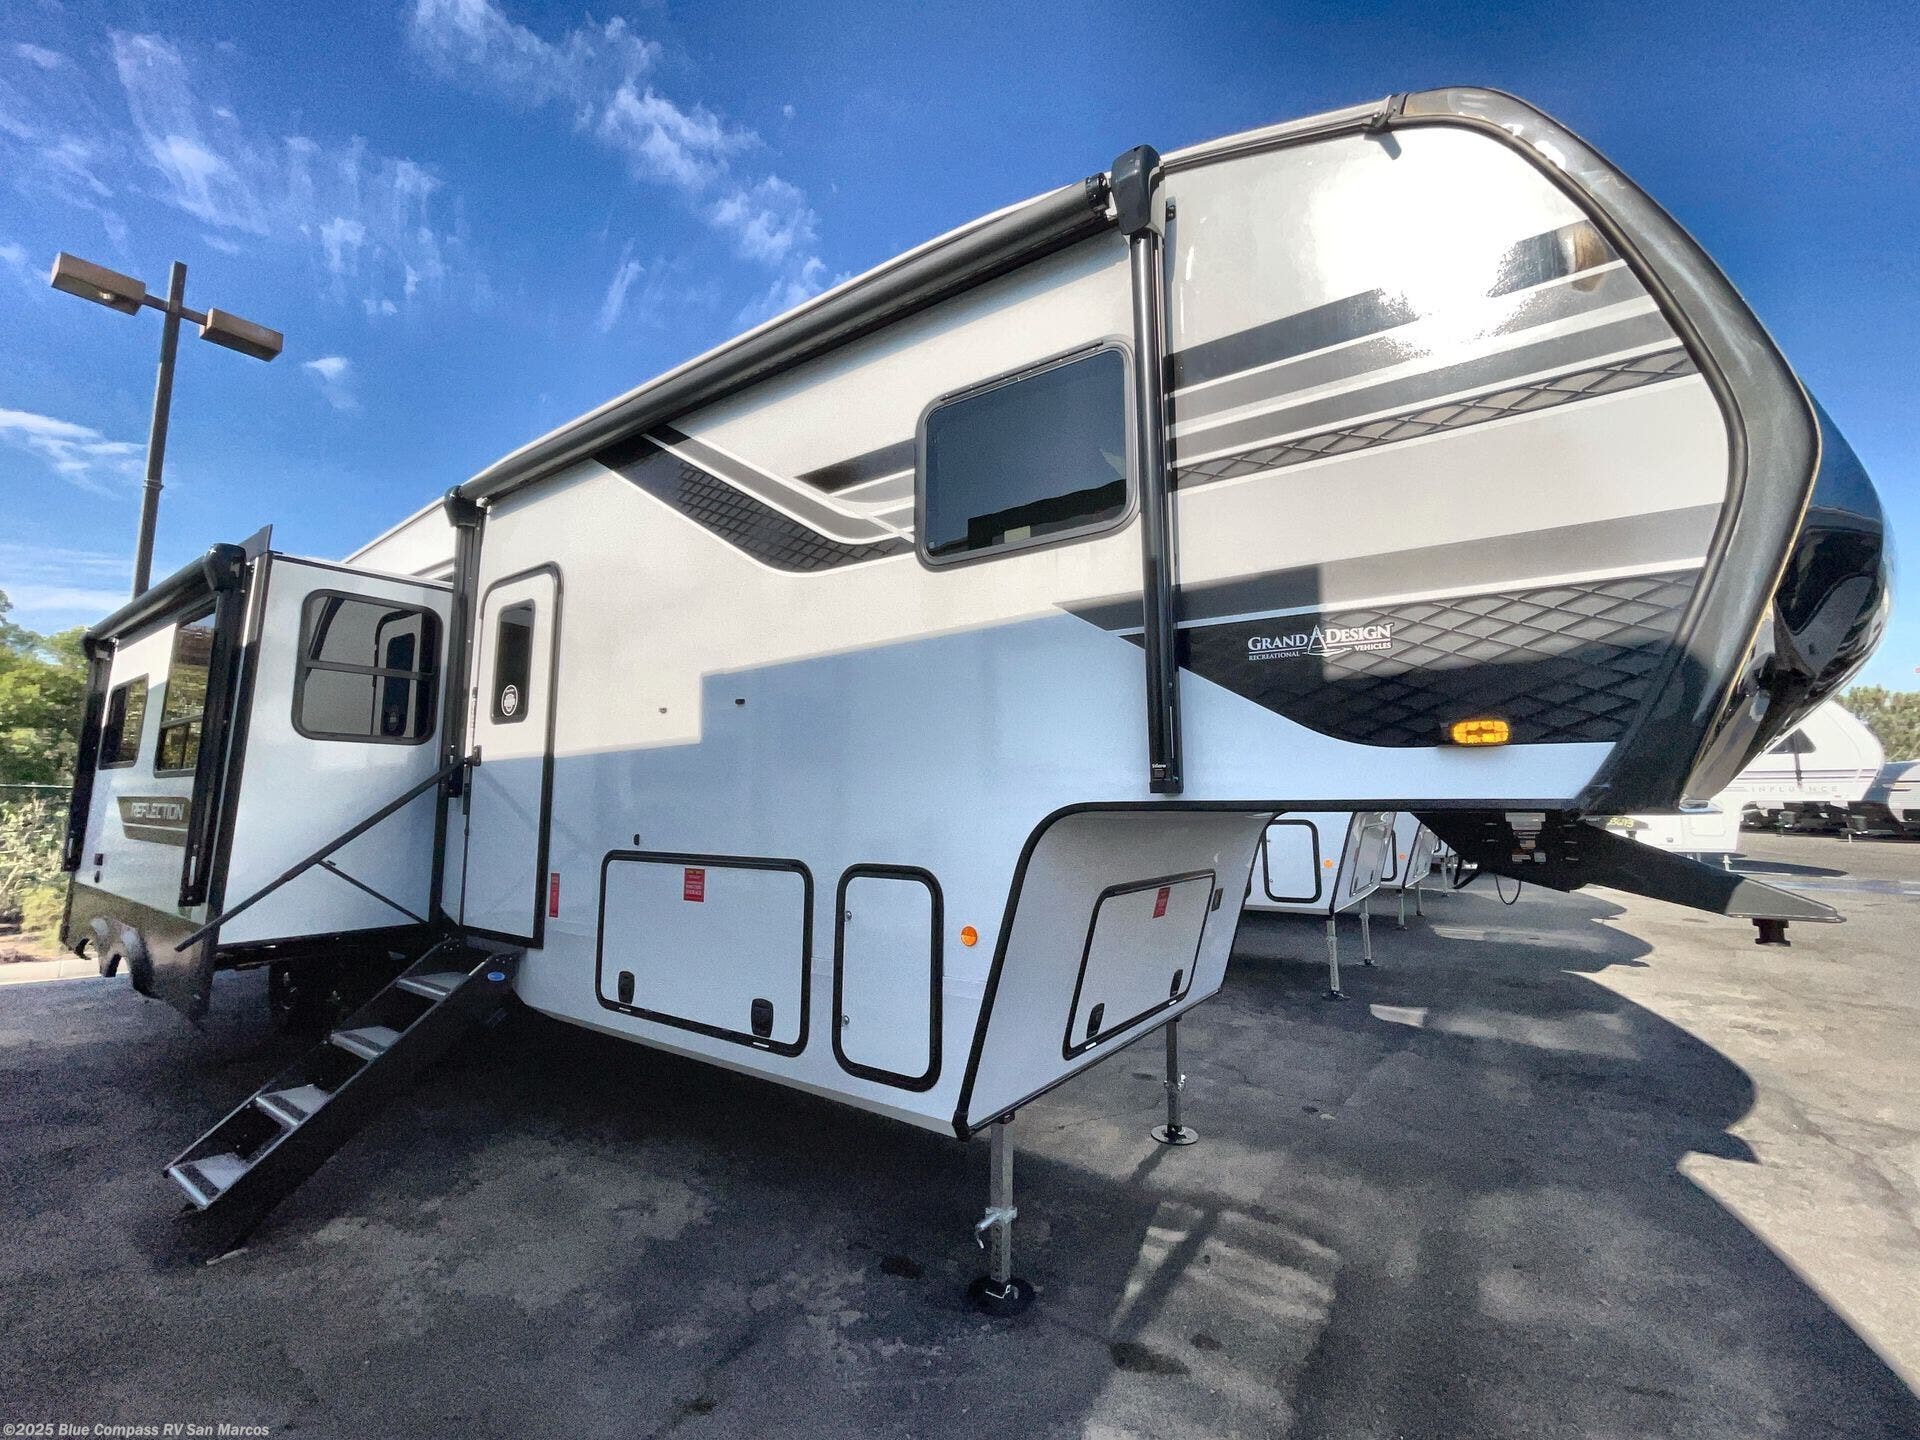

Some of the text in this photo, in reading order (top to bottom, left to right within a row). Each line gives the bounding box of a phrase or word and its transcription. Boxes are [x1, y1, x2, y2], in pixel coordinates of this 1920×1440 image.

[1248, 623, 1393, 651] GRAND DESIGN
[1248, 643, 1392, 661] RECREATIONAL VEHICLES
[1751, 785, 1838, 793] INFLUNCE
[131, 802, 185, 821] REFLECTION
